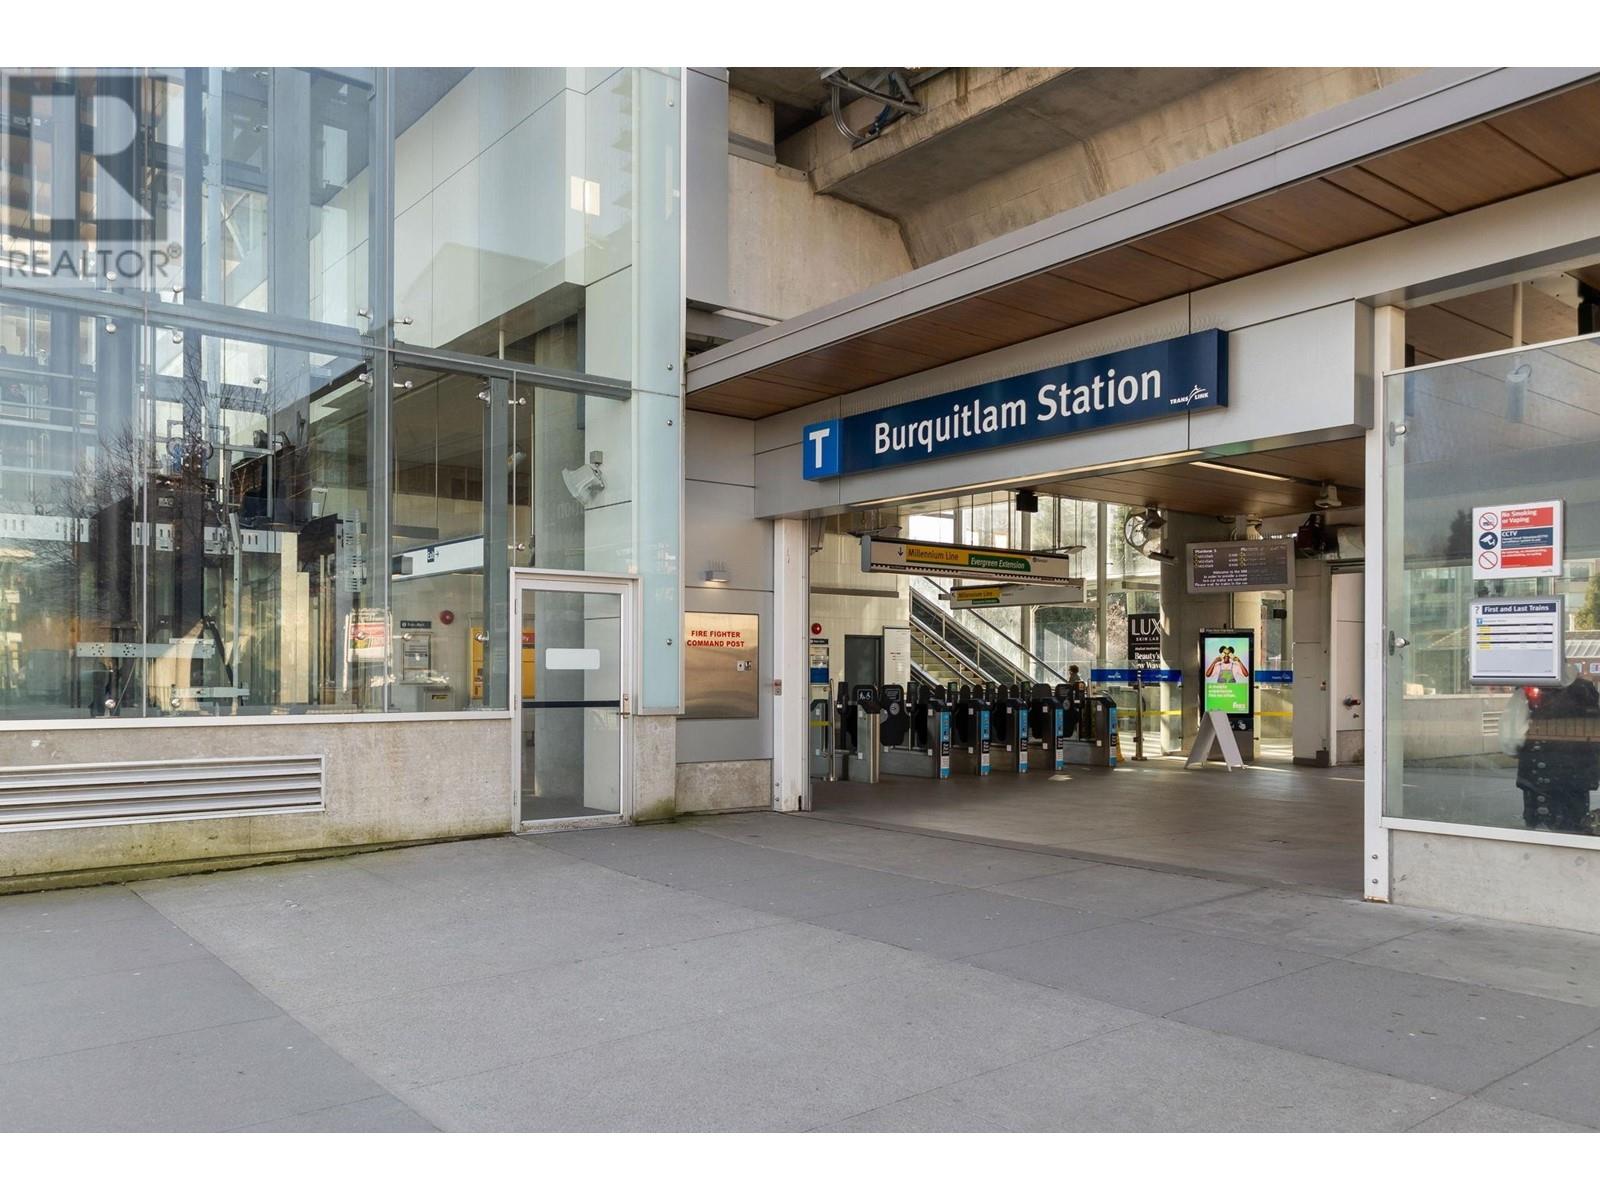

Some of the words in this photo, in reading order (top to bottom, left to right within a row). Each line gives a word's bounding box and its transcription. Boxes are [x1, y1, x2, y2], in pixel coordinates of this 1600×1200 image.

[874, 399, 1027, 455] Burquitlam
[1036, 367, 1162, 422] Station
[809, 428, 831, 469] T
[1511, 509, 1538, 518] Smoking
[1509, 516, 1531, 524] Vaping
[908, 549, 945, 561] Millennium
[945, 551, 960, 562] Line
[970, 556, 998, 568] Evergreen
[998, 558, 1026, 570] Extension
[1499, 605, 1513, 613] and
[1513, 604, 1529, 612] Last
[1528, 604, 1550, 612] Trains
[1131, 618, 1161, 636] LUX
[709, 630, 741, 638] FIGHTER
[686, 639, 725, 648] COMMAND
[726, 640, 745, 648] POST
